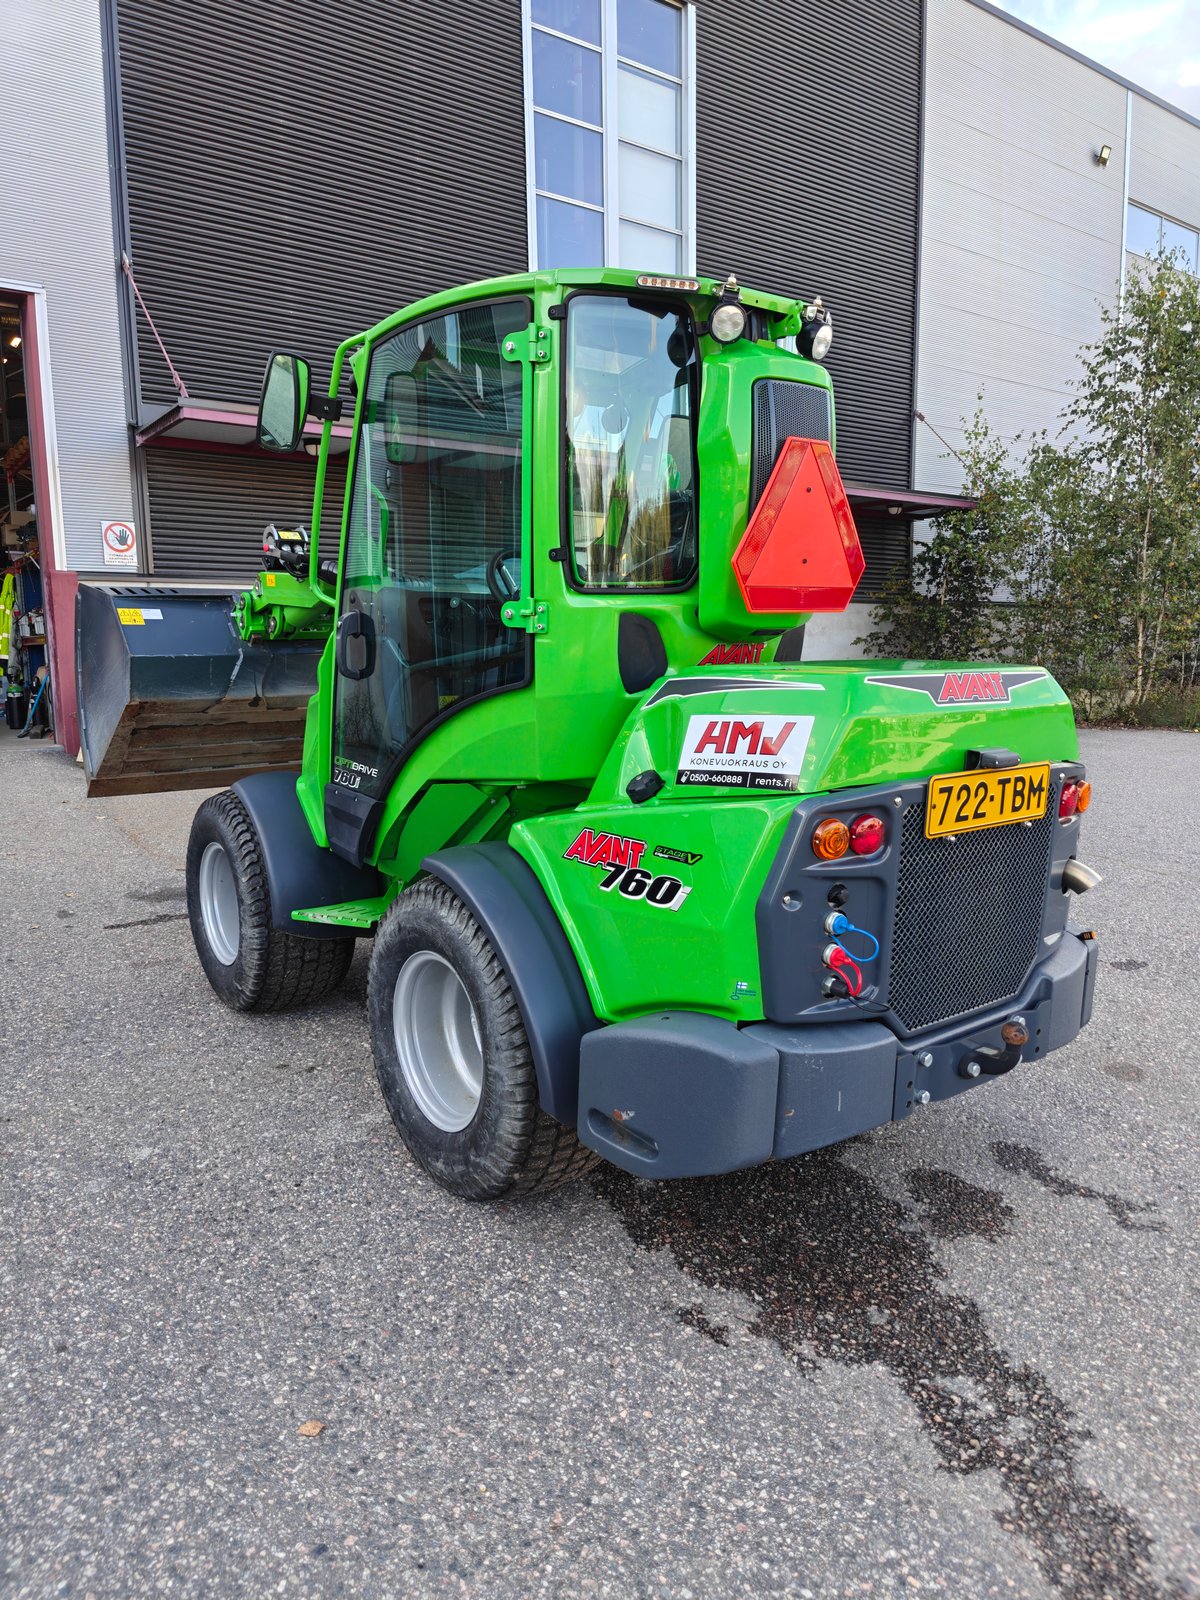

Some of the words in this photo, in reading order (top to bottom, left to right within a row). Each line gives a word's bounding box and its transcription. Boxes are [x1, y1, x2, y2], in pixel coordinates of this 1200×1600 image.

[697, 643, 765, 666] AVANT
[938, 672, 1007, 702] AVANT
[689, 757, 769, 768] KONEVUOKRAUS
[772, 760, 788, 769] OY
[689, 773, 743, 784] 0500-660888
[755, 777, 793, 788] rents.fi
[938, 774, 1045, 826] 722-TBM
[562, 827, 648, 869] AVANT
[655, 846, 688, 859] STAGE
[687, 852, 702, 864] V
